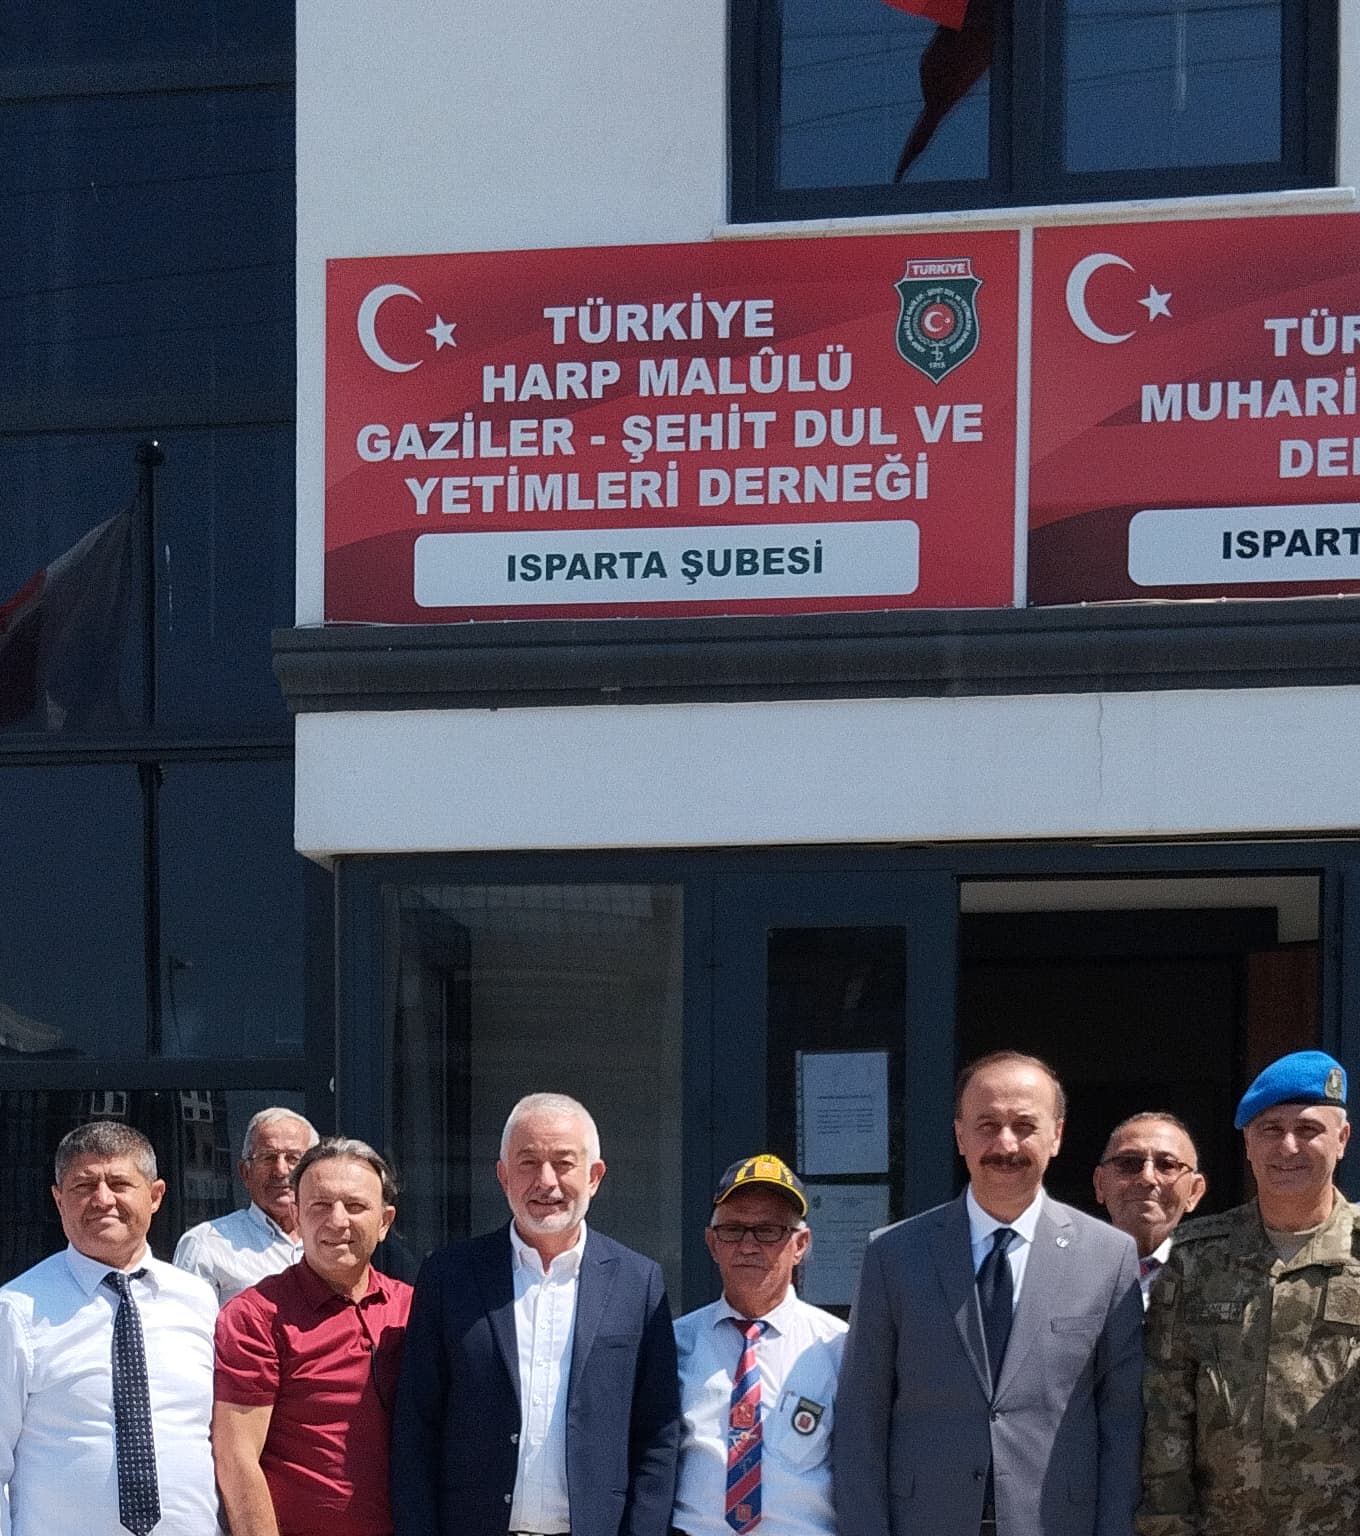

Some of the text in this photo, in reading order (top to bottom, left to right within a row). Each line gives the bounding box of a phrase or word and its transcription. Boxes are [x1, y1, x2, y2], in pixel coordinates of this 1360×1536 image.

[544, 293, 774, 344] TÜRKİYE
[483, 345, 851, 402] HARP MALÛLÜ
[357, 403, 983, 463] GAZİLER - ŞEHİT DUL VE
[405, 453, 928, 514] YETİMLERİ DERNEĞİ
[508, 539, 822, 585] ISPARTA ŞUBESİ
